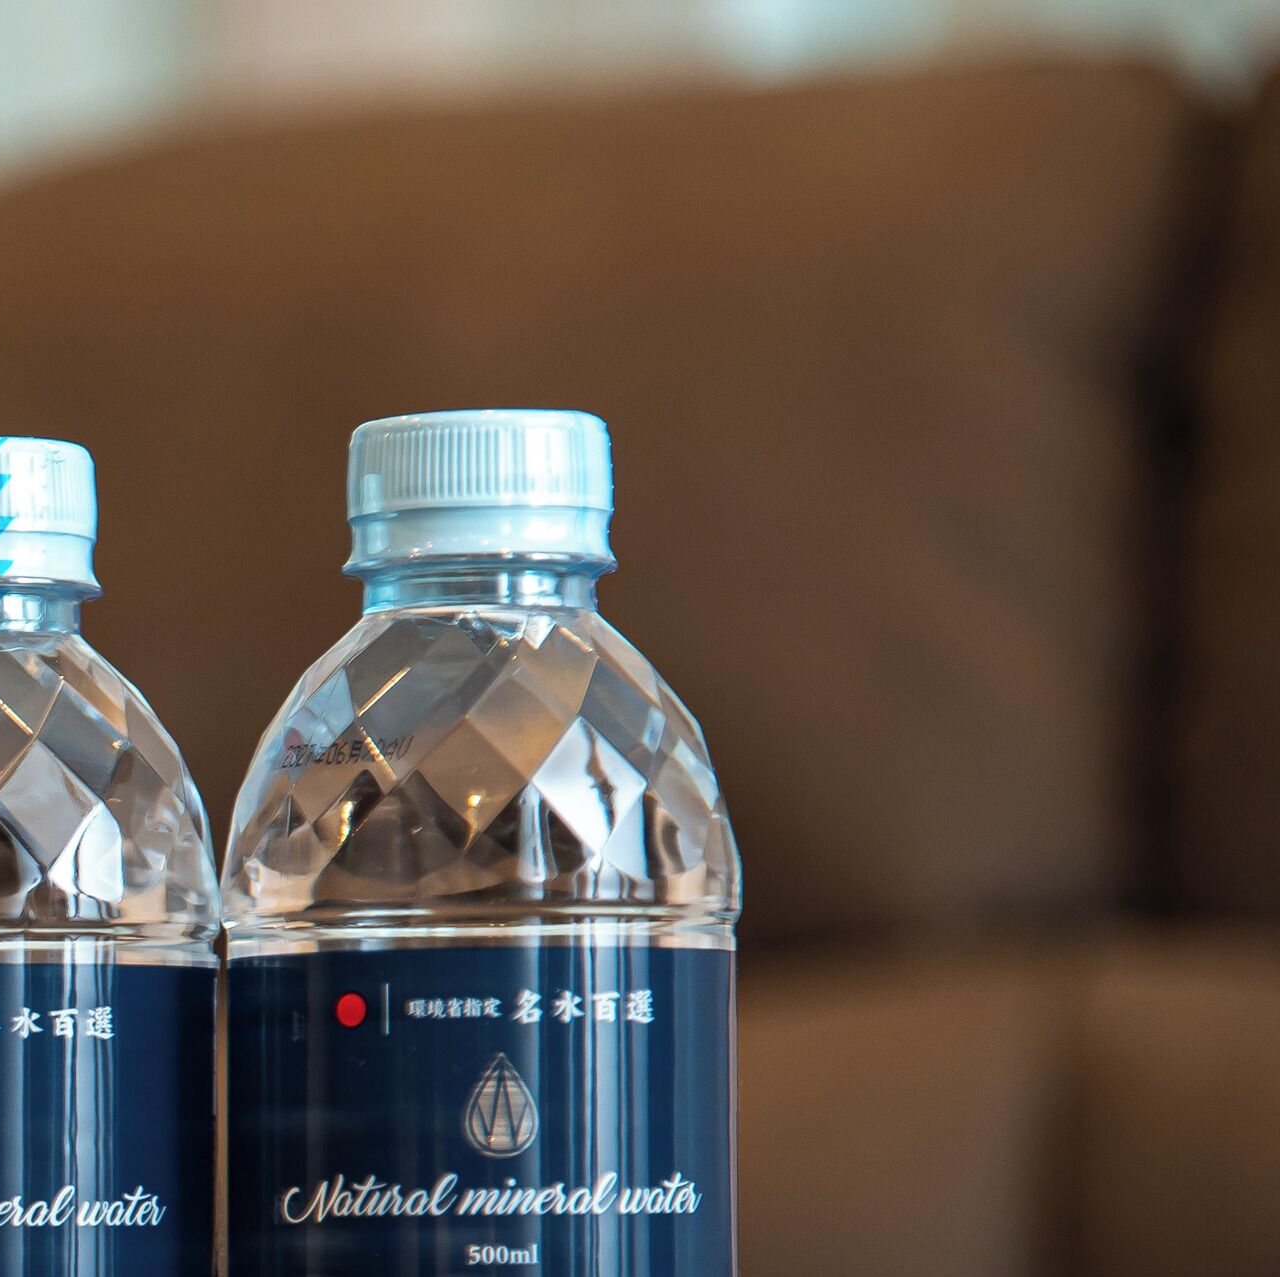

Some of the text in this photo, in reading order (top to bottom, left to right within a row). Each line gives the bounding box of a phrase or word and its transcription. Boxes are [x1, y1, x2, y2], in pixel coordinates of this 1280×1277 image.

[77, 1185, 166, 1227] water
[284, 1172, 702, 1223] Natural mineral water
[465, 1244, 540, 1266] 500ml
